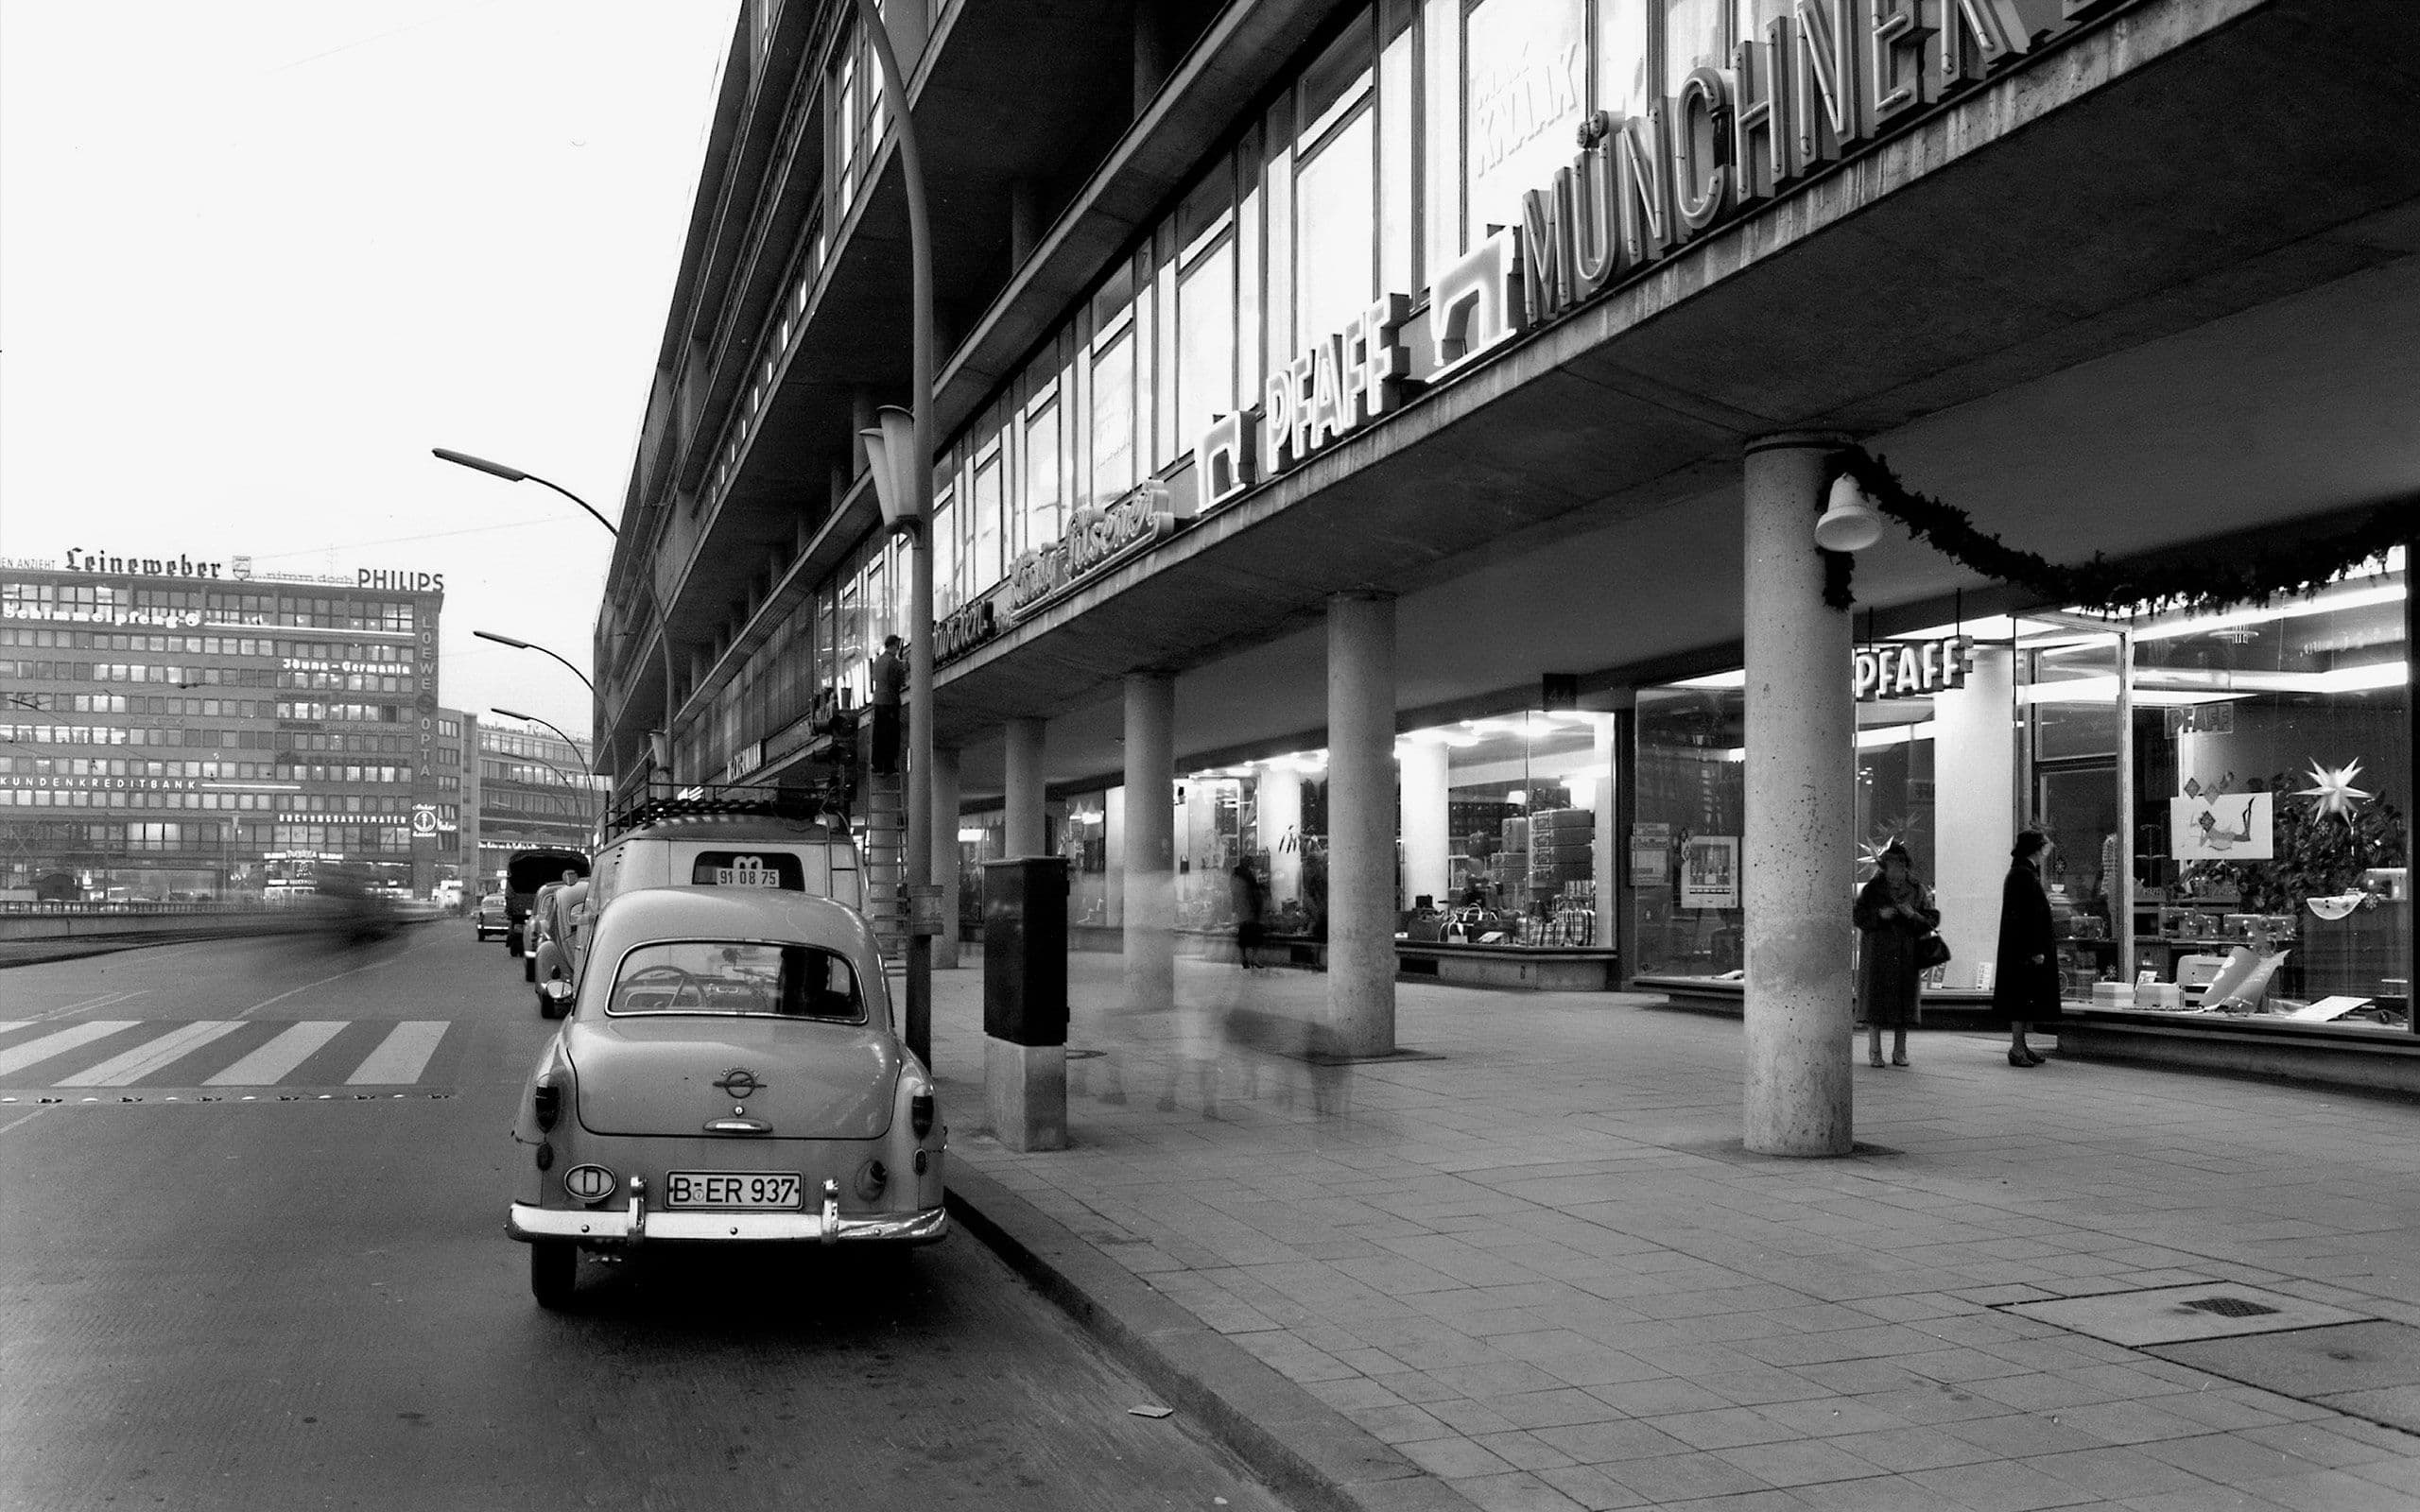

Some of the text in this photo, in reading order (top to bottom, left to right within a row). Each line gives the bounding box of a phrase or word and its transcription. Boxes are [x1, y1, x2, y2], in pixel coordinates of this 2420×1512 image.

[1266, 293, 1397, 474] PFAFF
[18, 558, 55, 571] ANZIEHT
[66, 547, 221, 579] Leineweber
[358, 568, 444, 592] PHILIPS
[1856, 638, 1961, 698] PFAFF
[420, 616, 435, 777] LOEWE OPTA
[0, 777, 197, 789] KUNDENKREDITBANK
[720, 870, 776, 885] 91 08 75
[582, 1169, 601, 1194] D
[751, 1178, 795, 1203] 937
